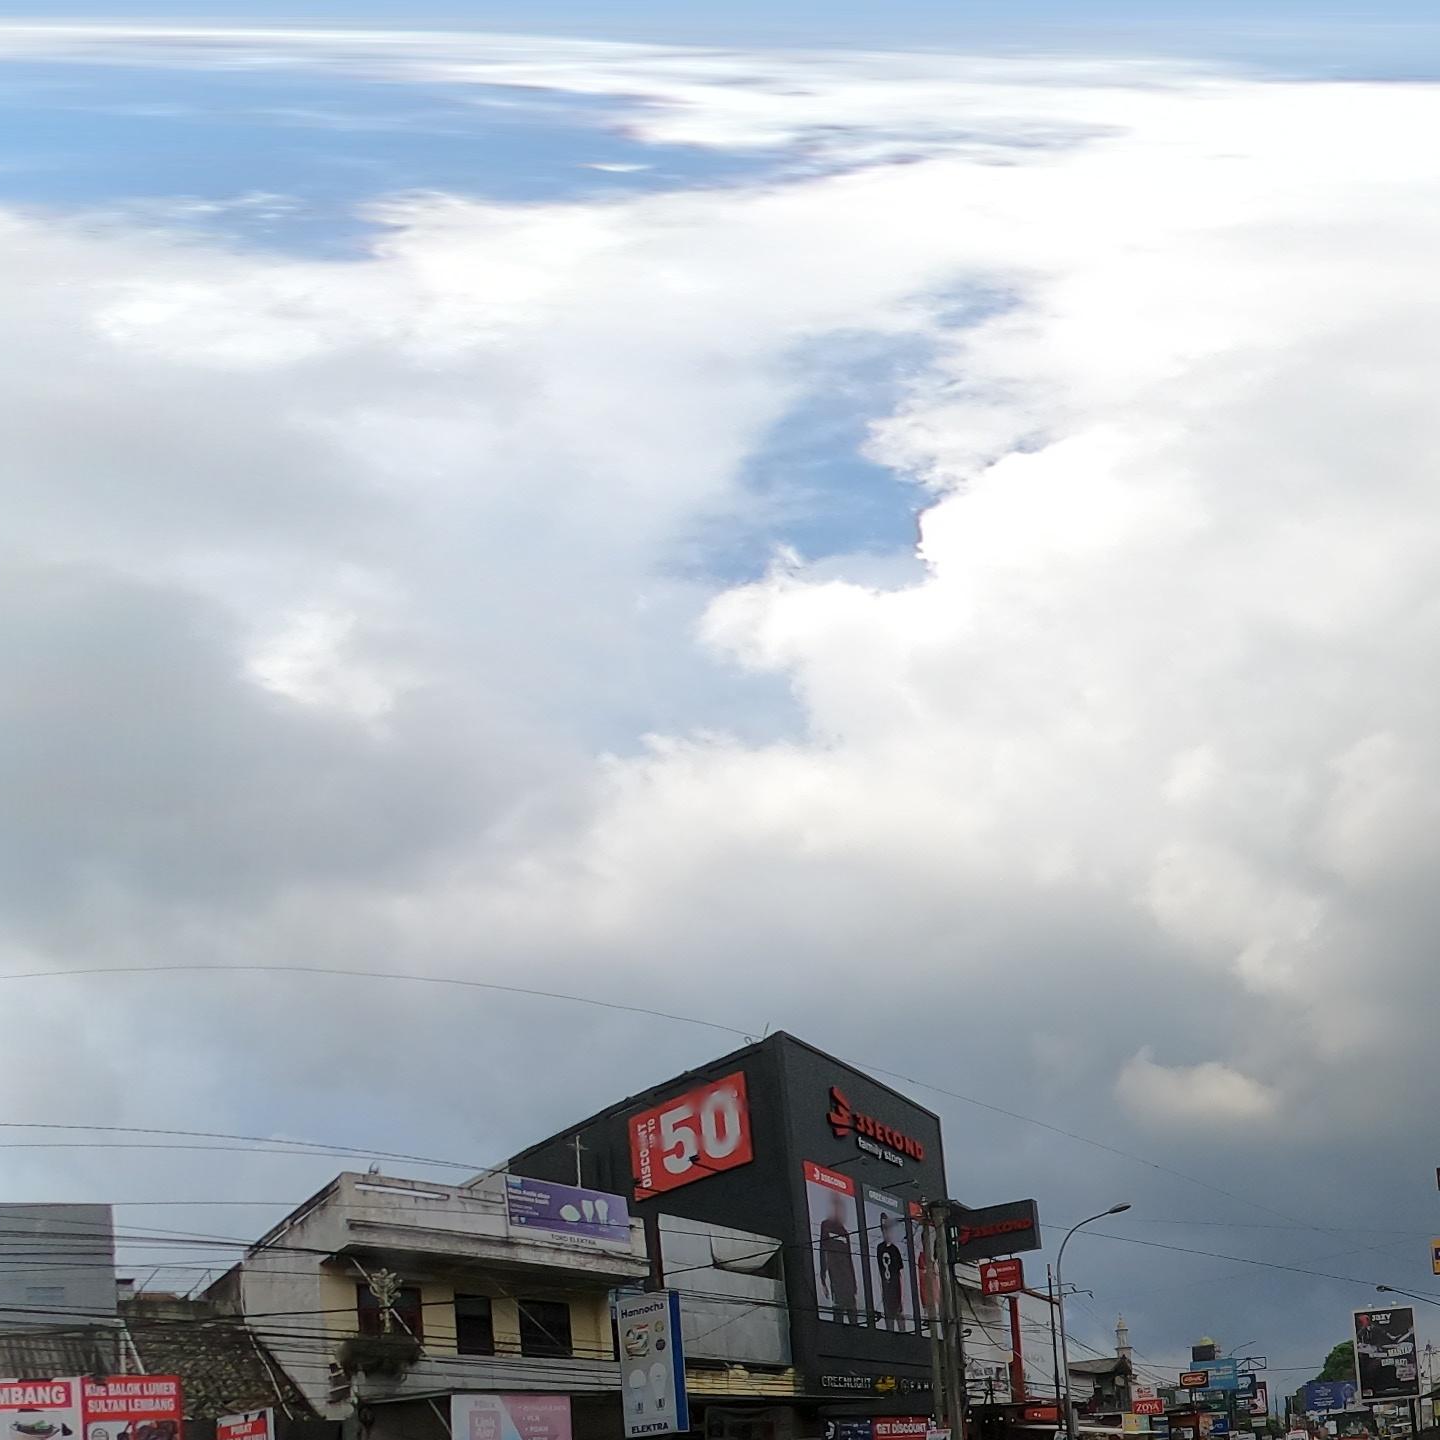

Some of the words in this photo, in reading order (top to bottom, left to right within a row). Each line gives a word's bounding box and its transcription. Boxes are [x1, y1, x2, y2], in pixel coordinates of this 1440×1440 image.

[660, 1090, 740, 1174] 50
[856, 1112, 925, 1160] 3SECOND
[858, 1136, 883, 1159] family
[884, 1151, 904, 1167] store
[621, 1301, 665, 1319] Hannochs
[88, 1400, 126, 1412] SULTAN
[129, 1398, 175, 1412] LEMBANG
[631, 1422, 669, 1434] ELEKTRA
[876, 1424, 890, 1434] GET
[892, 1423, 926, 1434] DISCOUNT
